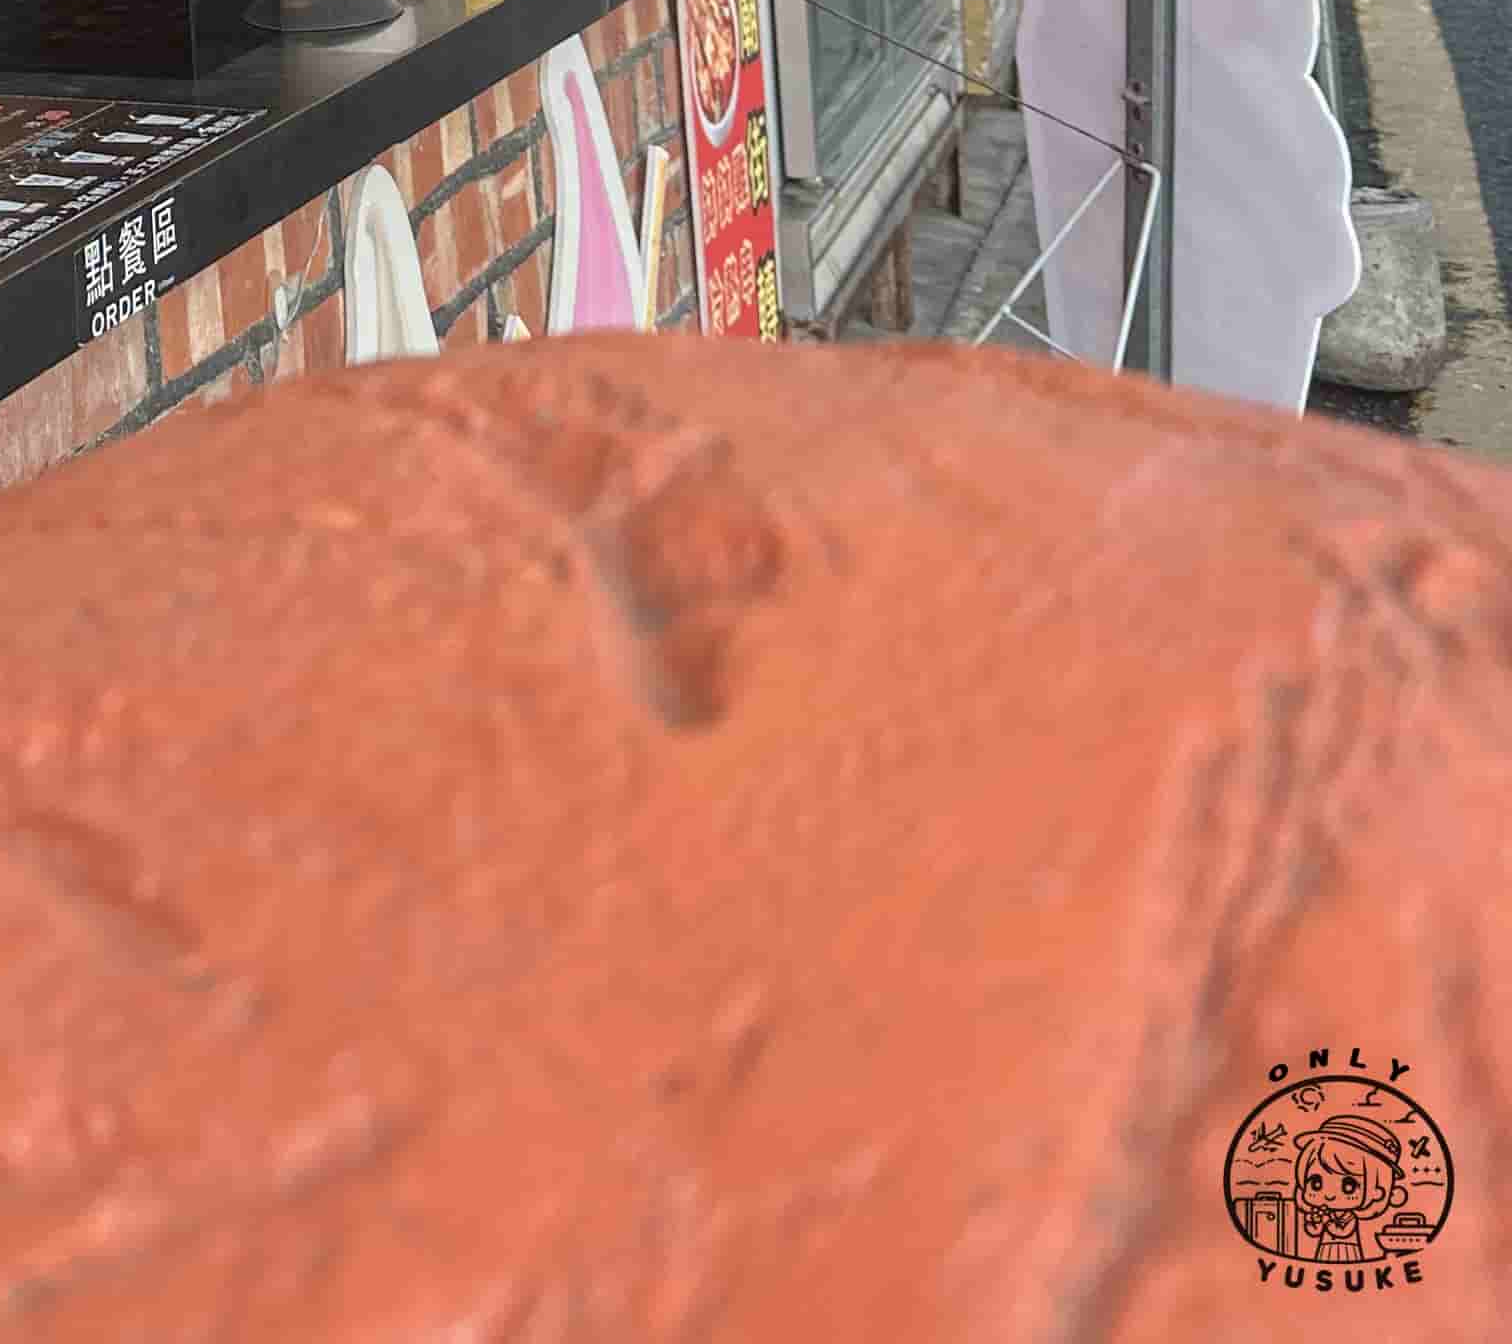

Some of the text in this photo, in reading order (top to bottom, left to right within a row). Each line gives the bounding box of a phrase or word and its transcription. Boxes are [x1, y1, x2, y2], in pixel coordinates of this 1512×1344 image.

[84, 196, 179, 308] 點餐區
[90, 278, 158, 339] ORDER
